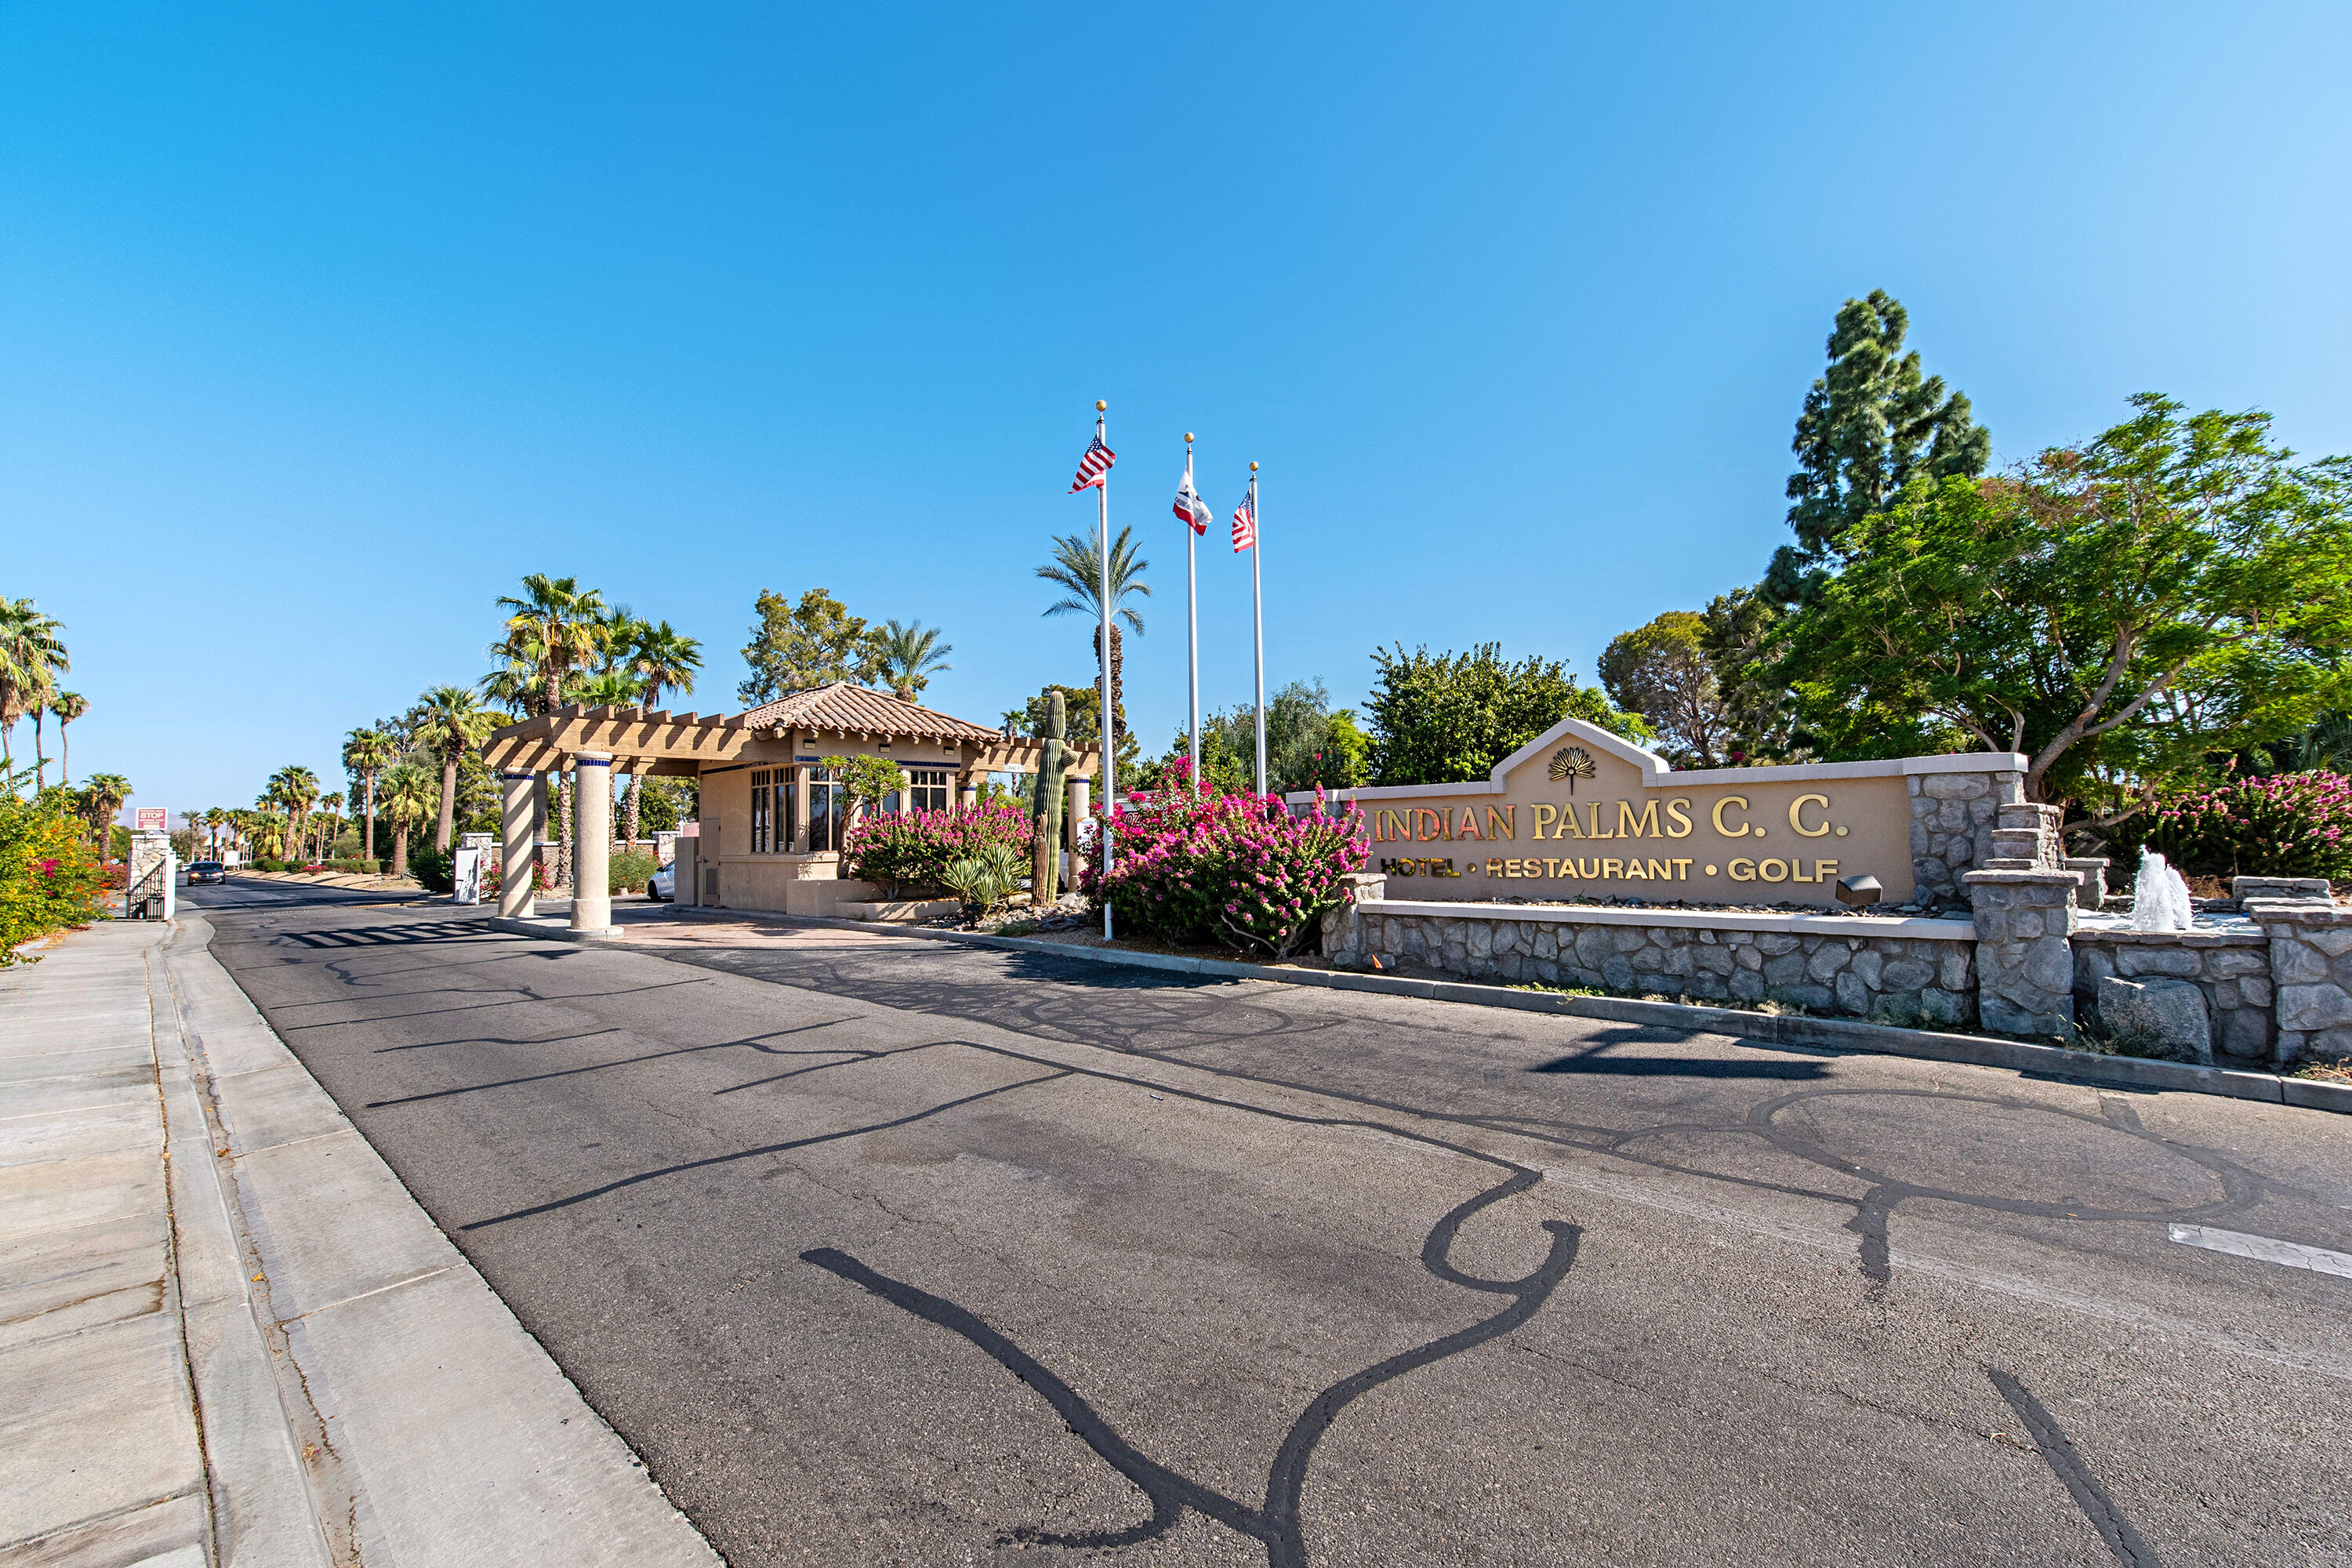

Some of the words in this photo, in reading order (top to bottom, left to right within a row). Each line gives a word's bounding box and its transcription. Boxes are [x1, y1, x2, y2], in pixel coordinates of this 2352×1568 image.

[1373, 804, 1516, 842] INDIAN
[1530, 797, 1693, 840] PALMS
[1711, 795, 1766, 838] C.
[1788, 793, 1849, 837] C.
[1381, 858, 1461, 877] HOTEL
[1486, 858, 1693, 880] RESTAURANT
[1727, 858, 1838, 883] GOLF
